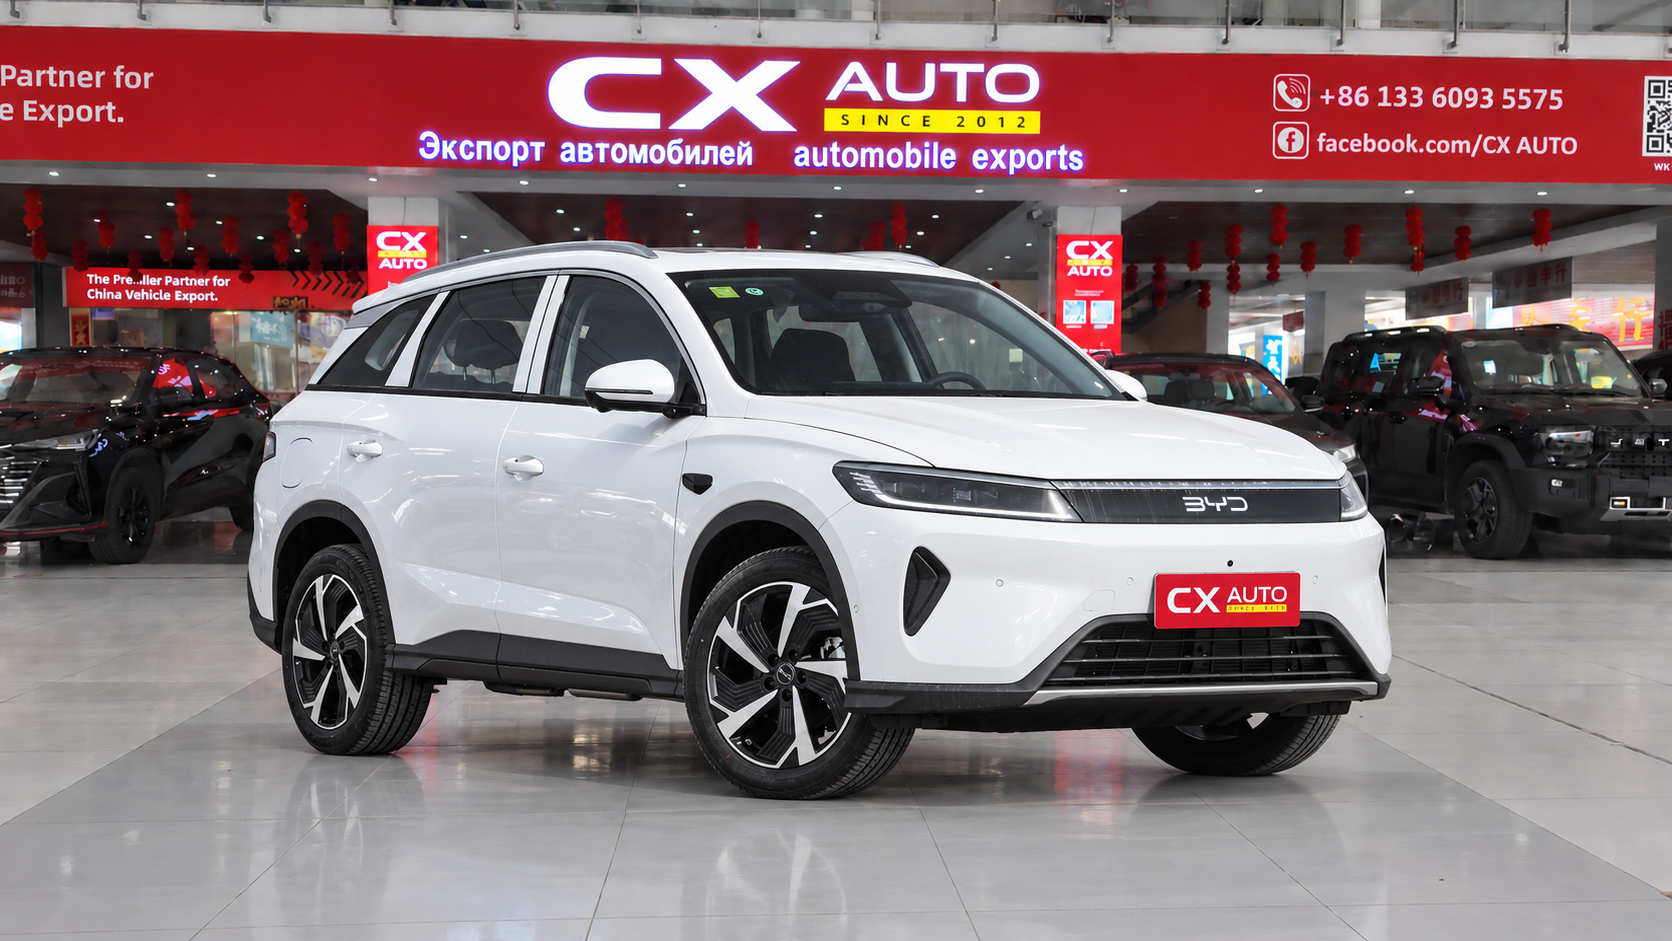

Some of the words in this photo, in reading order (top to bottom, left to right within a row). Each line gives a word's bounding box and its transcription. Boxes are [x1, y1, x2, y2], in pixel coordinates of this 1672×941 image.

[1, 65, 106, 88] Partner
[114, 65, 154, 89] for
[548, 57, 800, 132] CX
[825, 61, 1040, 103] AUTO
[1320, 85, 1369, 107] +86
[1377, 86, 1424, 108] 133
[1432, 87, 1494, 109] 6093
[1502, 88, 1563, 110] 5575
[24, 100, 124, 128] Export.
[841, 114, 931, 127] SINCE
[956, 116, 1026, 128] 2012
[418, 131, 545, 167] Экспорт
[560, 138, 753, 166] автомобилей
[1317, 133, 1513, 157] facebook.com/CX
[1516, 136, 1578, 155] AUTO
[793, 141, 957, 170] automobile
[972, 144, 1084, 175] exports
[376, 231, 427, 251] CX
[1066, 240, 1113, 259] CX
[378, 258, 428, 269] AUTO
[1067, 266, 1113, 276] AUTO
[87, 274, 110, 285] The
[165, 275, 210, 287] Partner
[212, 275, 231, 287] for
[87, 288, 122, 300] China
[125, 289, 171, 301] Vehicle
[174, 290, 218, 303] Export.
[1182, 496, 1249, 512] BYD
[1167, 587, 1220, 613] CX
[1227, 586, 1287, 603] AUTO
